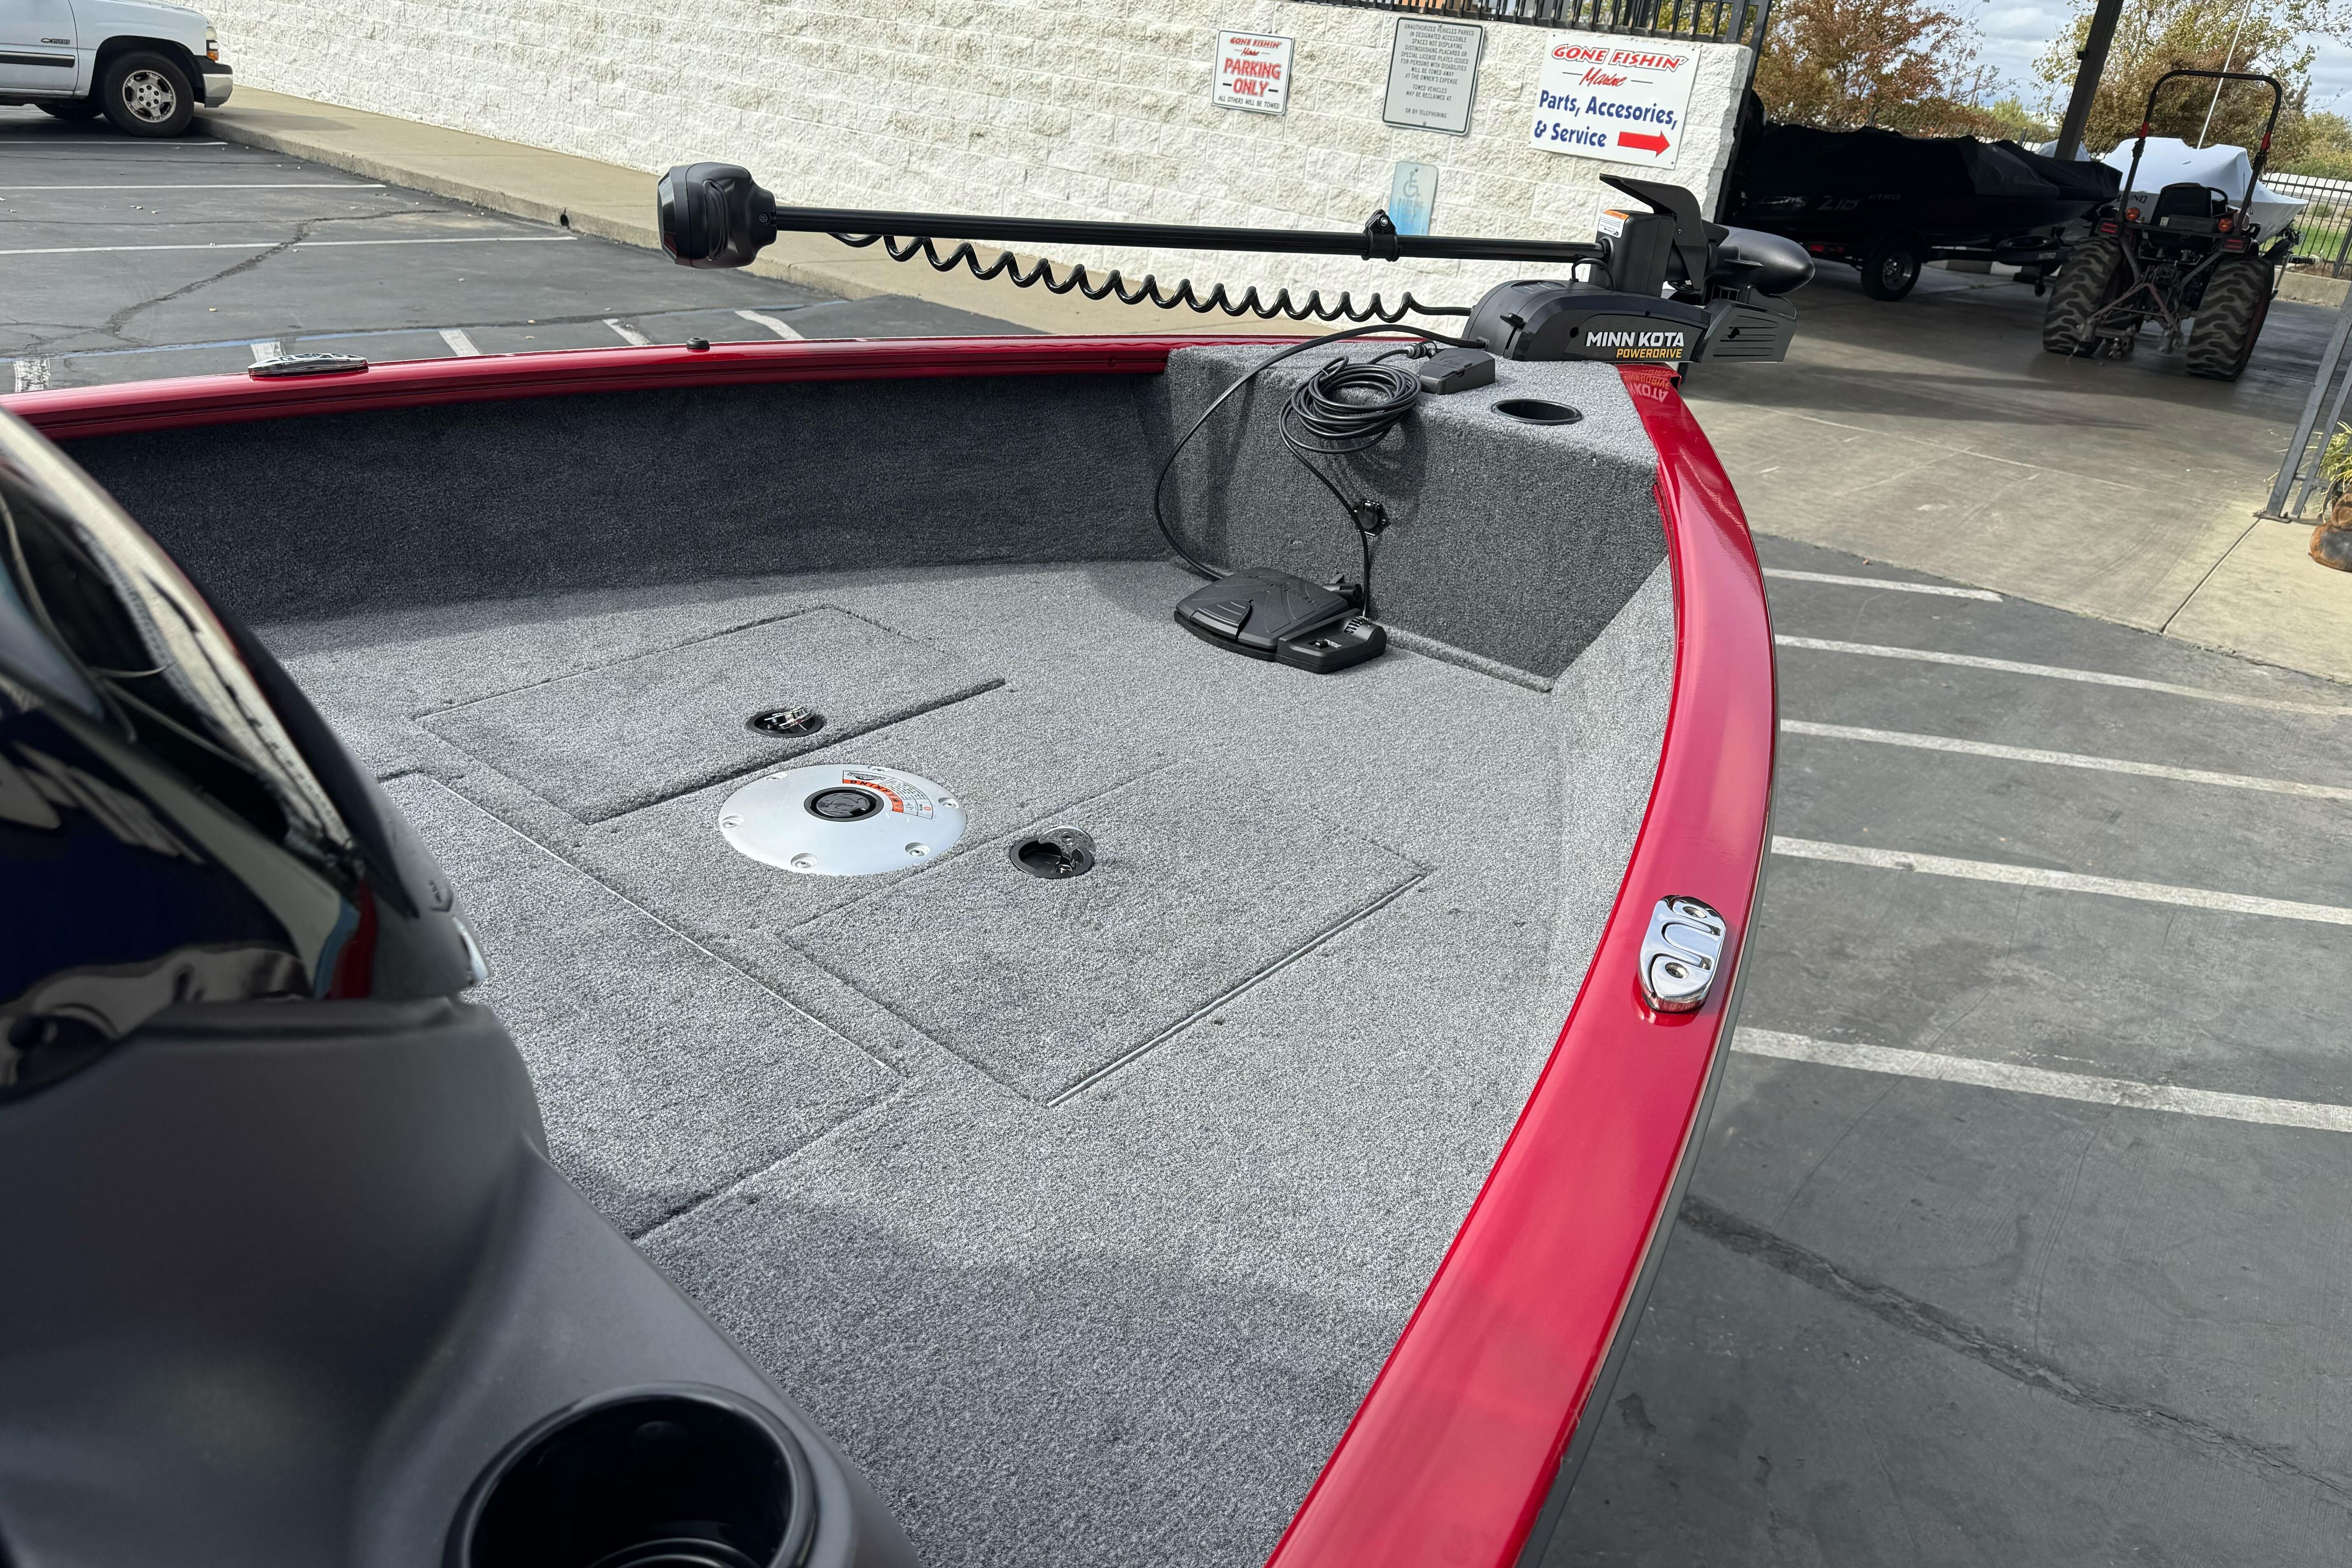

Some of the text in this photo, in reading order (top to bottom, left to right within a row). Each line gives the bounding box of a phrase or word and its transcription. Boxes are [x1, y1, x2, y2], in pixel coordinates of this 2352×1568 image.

[1230, 37, 1252, 45] GONE
[1405, 45, 1438, 54] DISTINGUISHING
[1552, 44, 1609, 63] GONE
[1223, 58, 1281, 80] PARKING
[1233, 77, 1269, 97] ONLY
[1422, 92, 1445, 101] RECLAIMED
[1539, 90, 1678, 130] Parts, Accesories,
[1534, 120, 1607, 147] & Service
[2116, 194, 2147, 203] LND
[1585, 332, 1684, 347] MINN KOTA
[1616, 348, 1683, 358] POWERDRIVE
